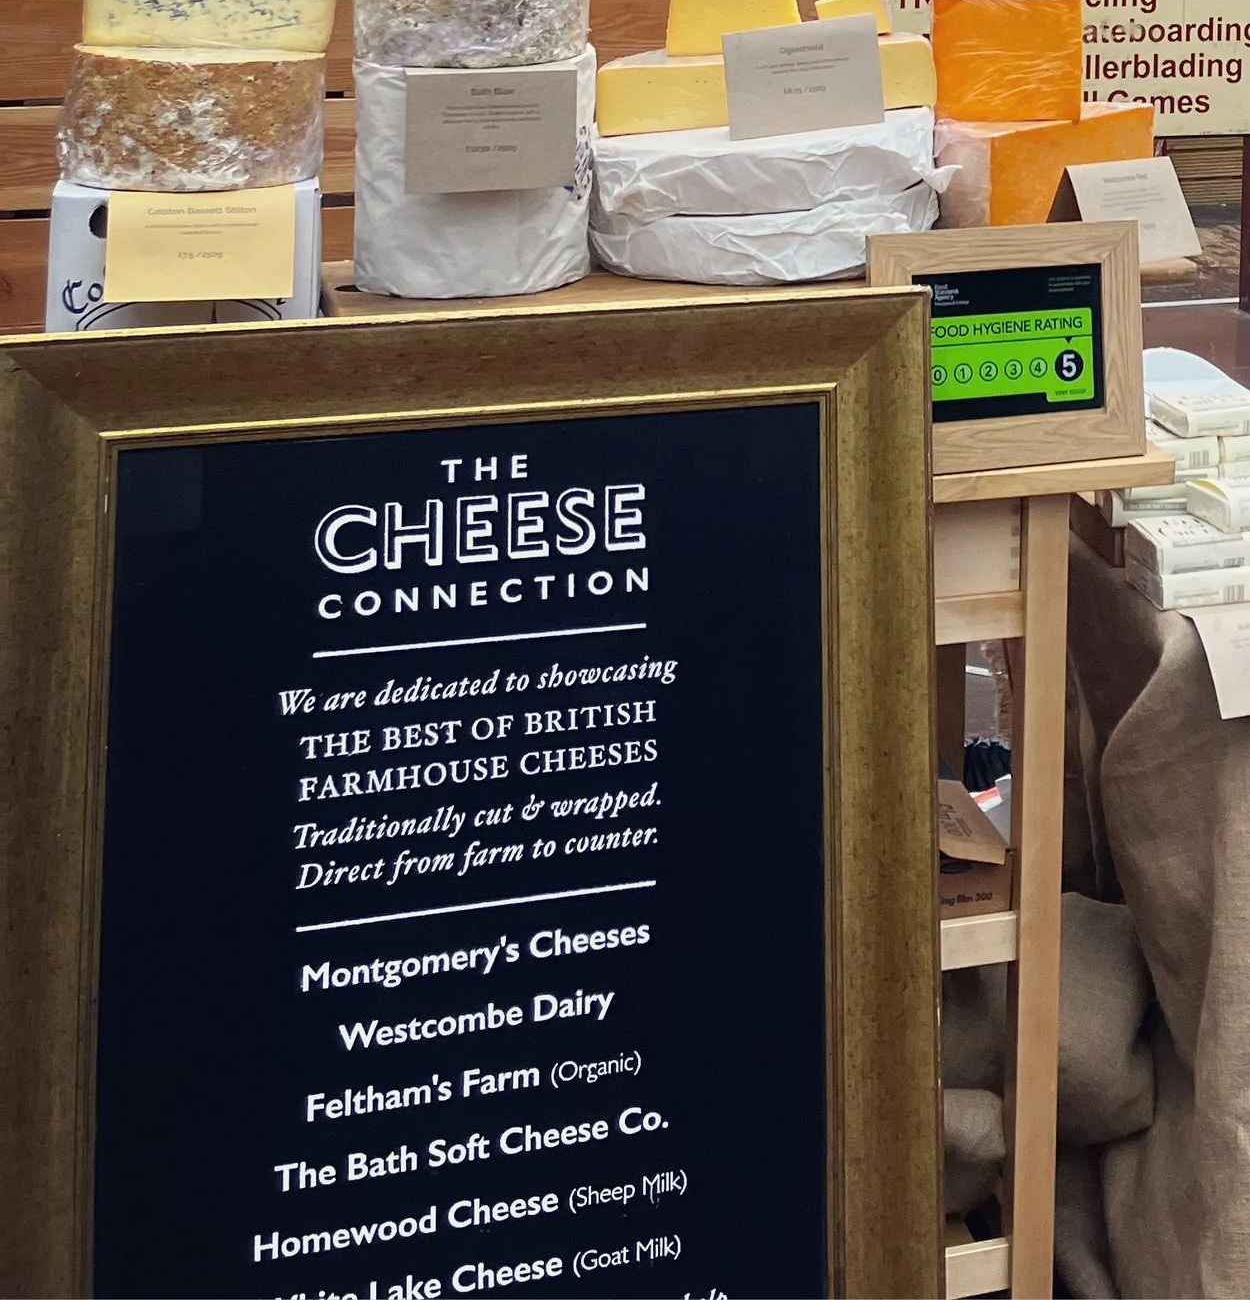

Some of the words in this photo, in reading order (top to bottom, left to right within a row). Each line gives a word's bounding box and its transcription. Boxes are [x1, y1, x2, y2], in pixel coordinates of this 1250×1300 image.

[1084, 53, 1243, 83] llerblading
[974, 320, 1032, 336] HYGIENE
[1035, 316, 1083, 331] RATING
[1062, 353, 1077, 378] 5
[440, 454, 528, 484] THE
[315, 484, 647, 574] CHEESE
[318, 566, 649, 620] CONNECTION
[279, 689, 316, 715] We
[323, 691, 367, 711] are
[373, 669, 501, 705] dedicated
[505, 672, 530, 692] to
[536, 655, 679, 690] showcasing
[300, 730, 372, 759] THE
[382, 719, 462, 751] BEST
[471, 715, 514, 741] OF
[524, 700, 657, 735] BRITISH
[298, 756, 509, 802] FARMHOUSE
[519, 740, 658, 776] CHEESES
[293, 805, 466, 850] Traditionally
[474, 804, 514, 827] cut
[521, 794, 546, 821] &
[551, 782, 662, 820] wrapped.
[296, 859, 386, 890] Direct
[387, 849, 455, 886] from
[456, 840, 525, 877] farm
[533, 838, 557, 859] to
[564, 827, 658, 855] counter.
[957, 894, 973, 903] film
[975, 892, 992, 902] 300
[300, 936, 520, 993] Montgomery's
[529, 925, 650, 959] Cheeses
[339, 1003, 524, 1051] Westcombe
[533, 990, 616, 1022] Dairy
[306, 1074, 452, 1123] Feltham's
[462, 1068, 540, 1098] Farm
[551, 1051, 642, 1088] (Organic)
[274, 1161, 337, 1193] The
[347, 1145, 418, 1181] Bath
[428, 1133, 491, 1168] Soft
[499, 1121, 609, 1155] Cheese
[618, 1107, 669, 1135] Co.
[253, 1206, 437, 1263] Homewood
[447, 1193, 559, 1229] Cheese
[568, 1183, 635, 1214] (Sheep
[641, 1169, 688, 1203] Milk)
[451, 1258, 563, 1292] Cheese
[572, 1246, 630, 1278] (Goat
[635, 1234, 682, 1263] Milk)
